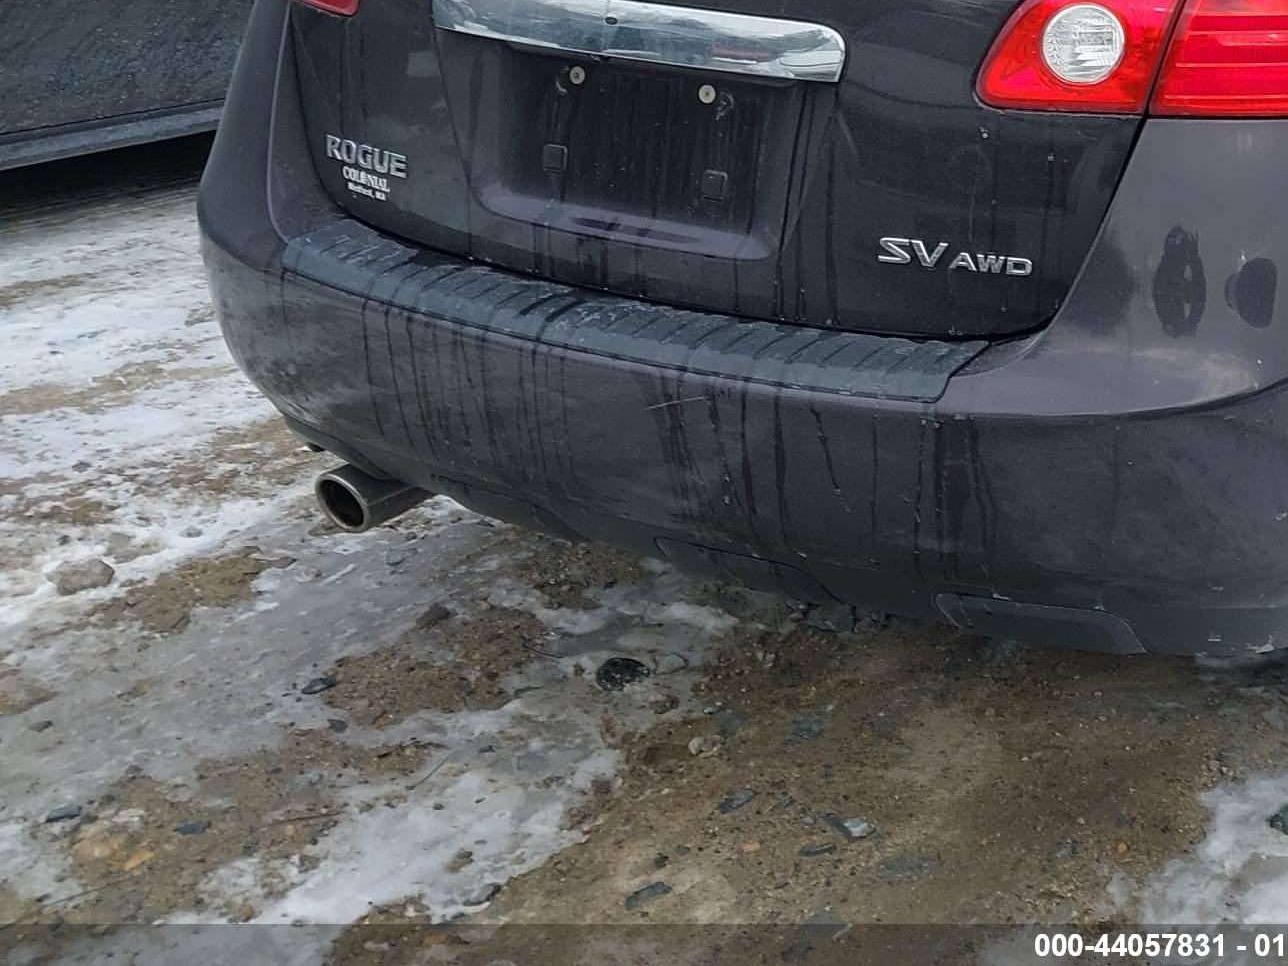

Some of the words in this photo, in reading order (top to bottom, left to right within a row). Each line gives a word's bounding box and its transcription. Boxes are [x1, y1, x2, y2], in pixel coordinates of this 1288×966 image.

[326, 134, 408, 179] ROGUE
[878, 237, 949, 268] SV
[950, 252, 1033, 276] AWD
